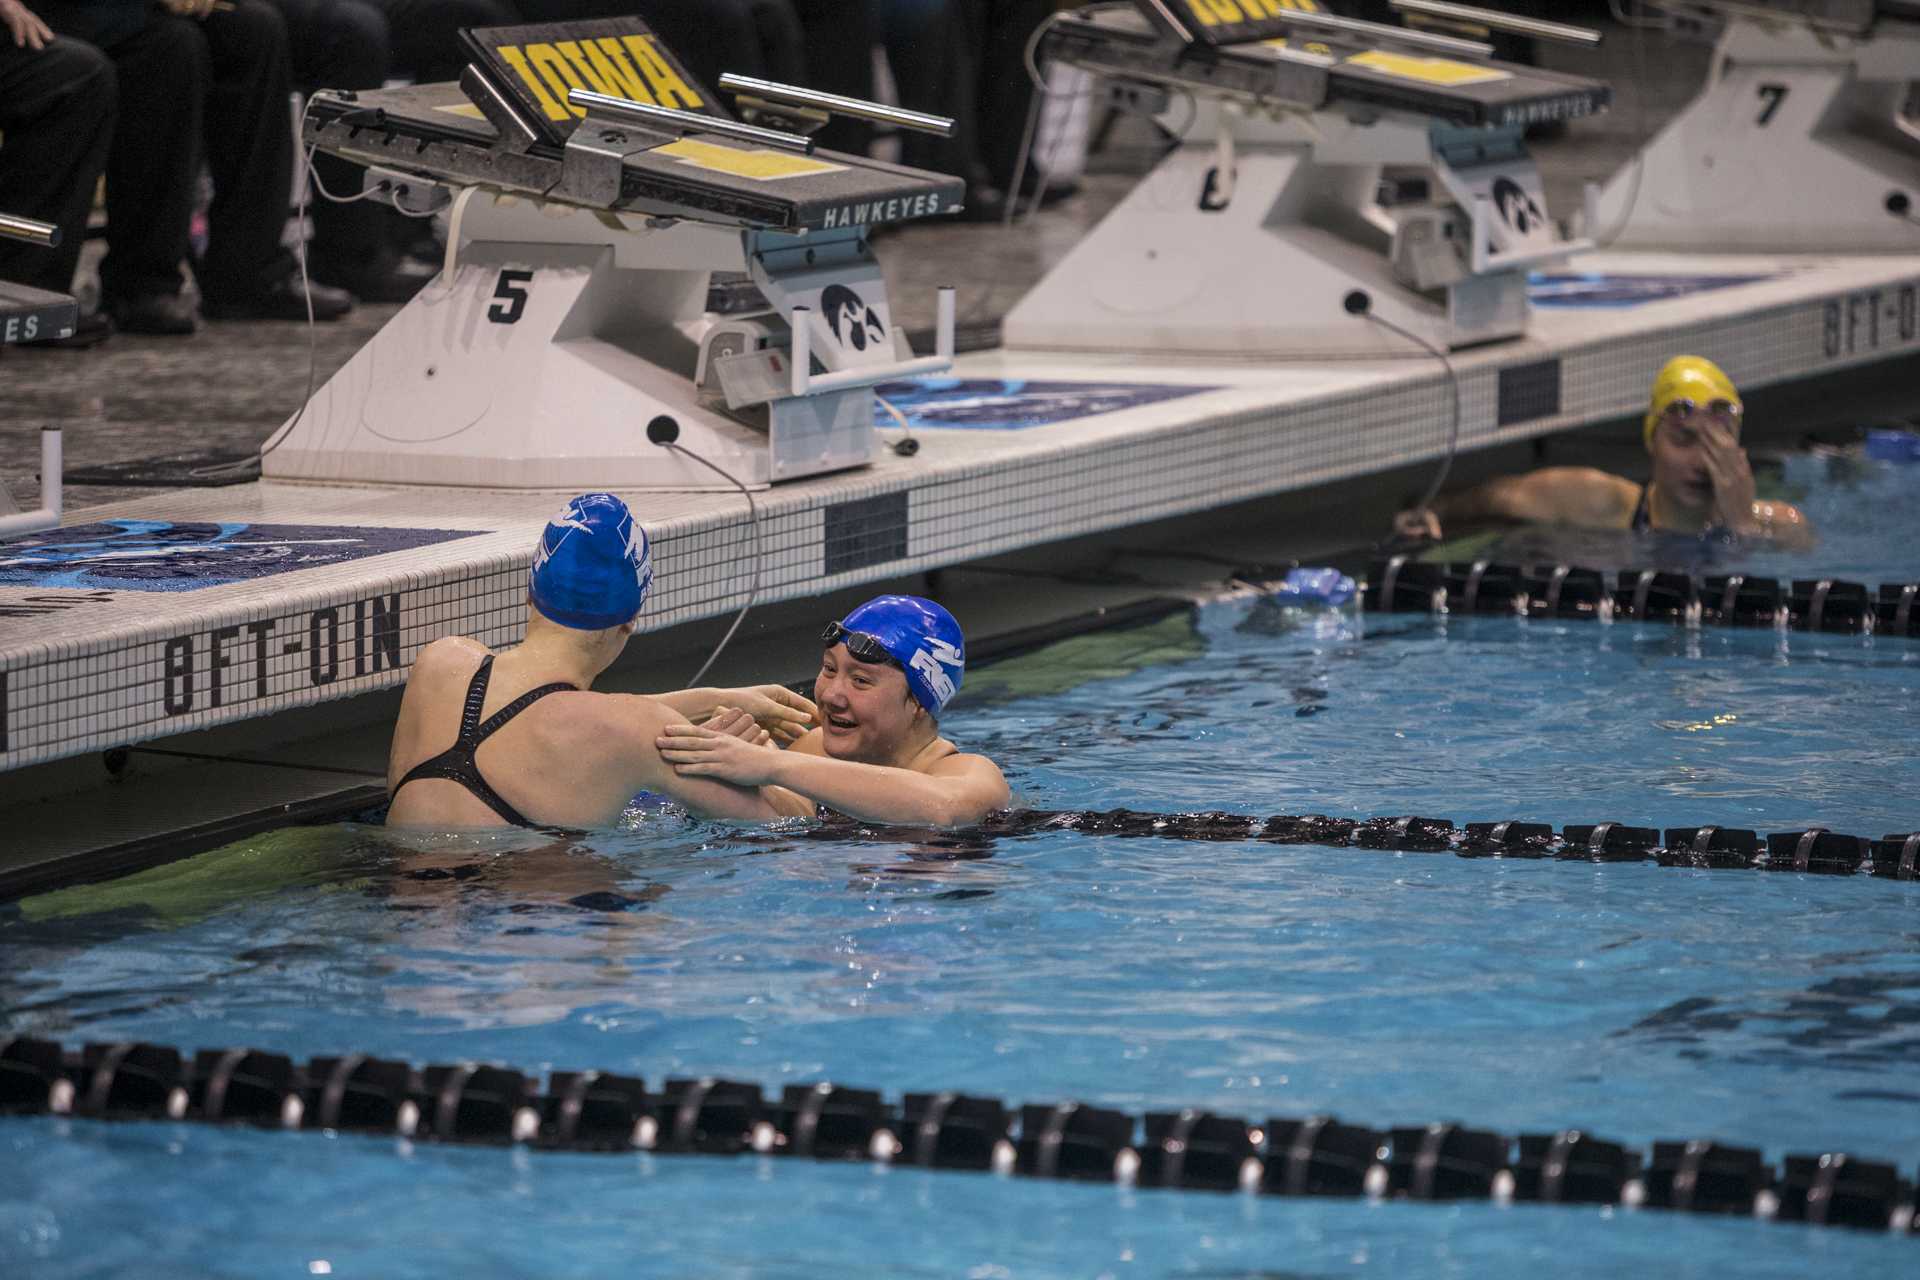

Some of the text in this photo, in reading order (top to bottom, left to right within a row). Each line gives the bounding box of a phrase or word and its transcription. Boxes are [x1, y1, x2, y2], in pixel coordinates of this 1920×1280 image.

[496, 34, 704, 121] IOWA
[1758, 84, 1789, 128] 7
[823, 192, 939, 229] HAWKEYES
[487, 269, 534, 325] 5
